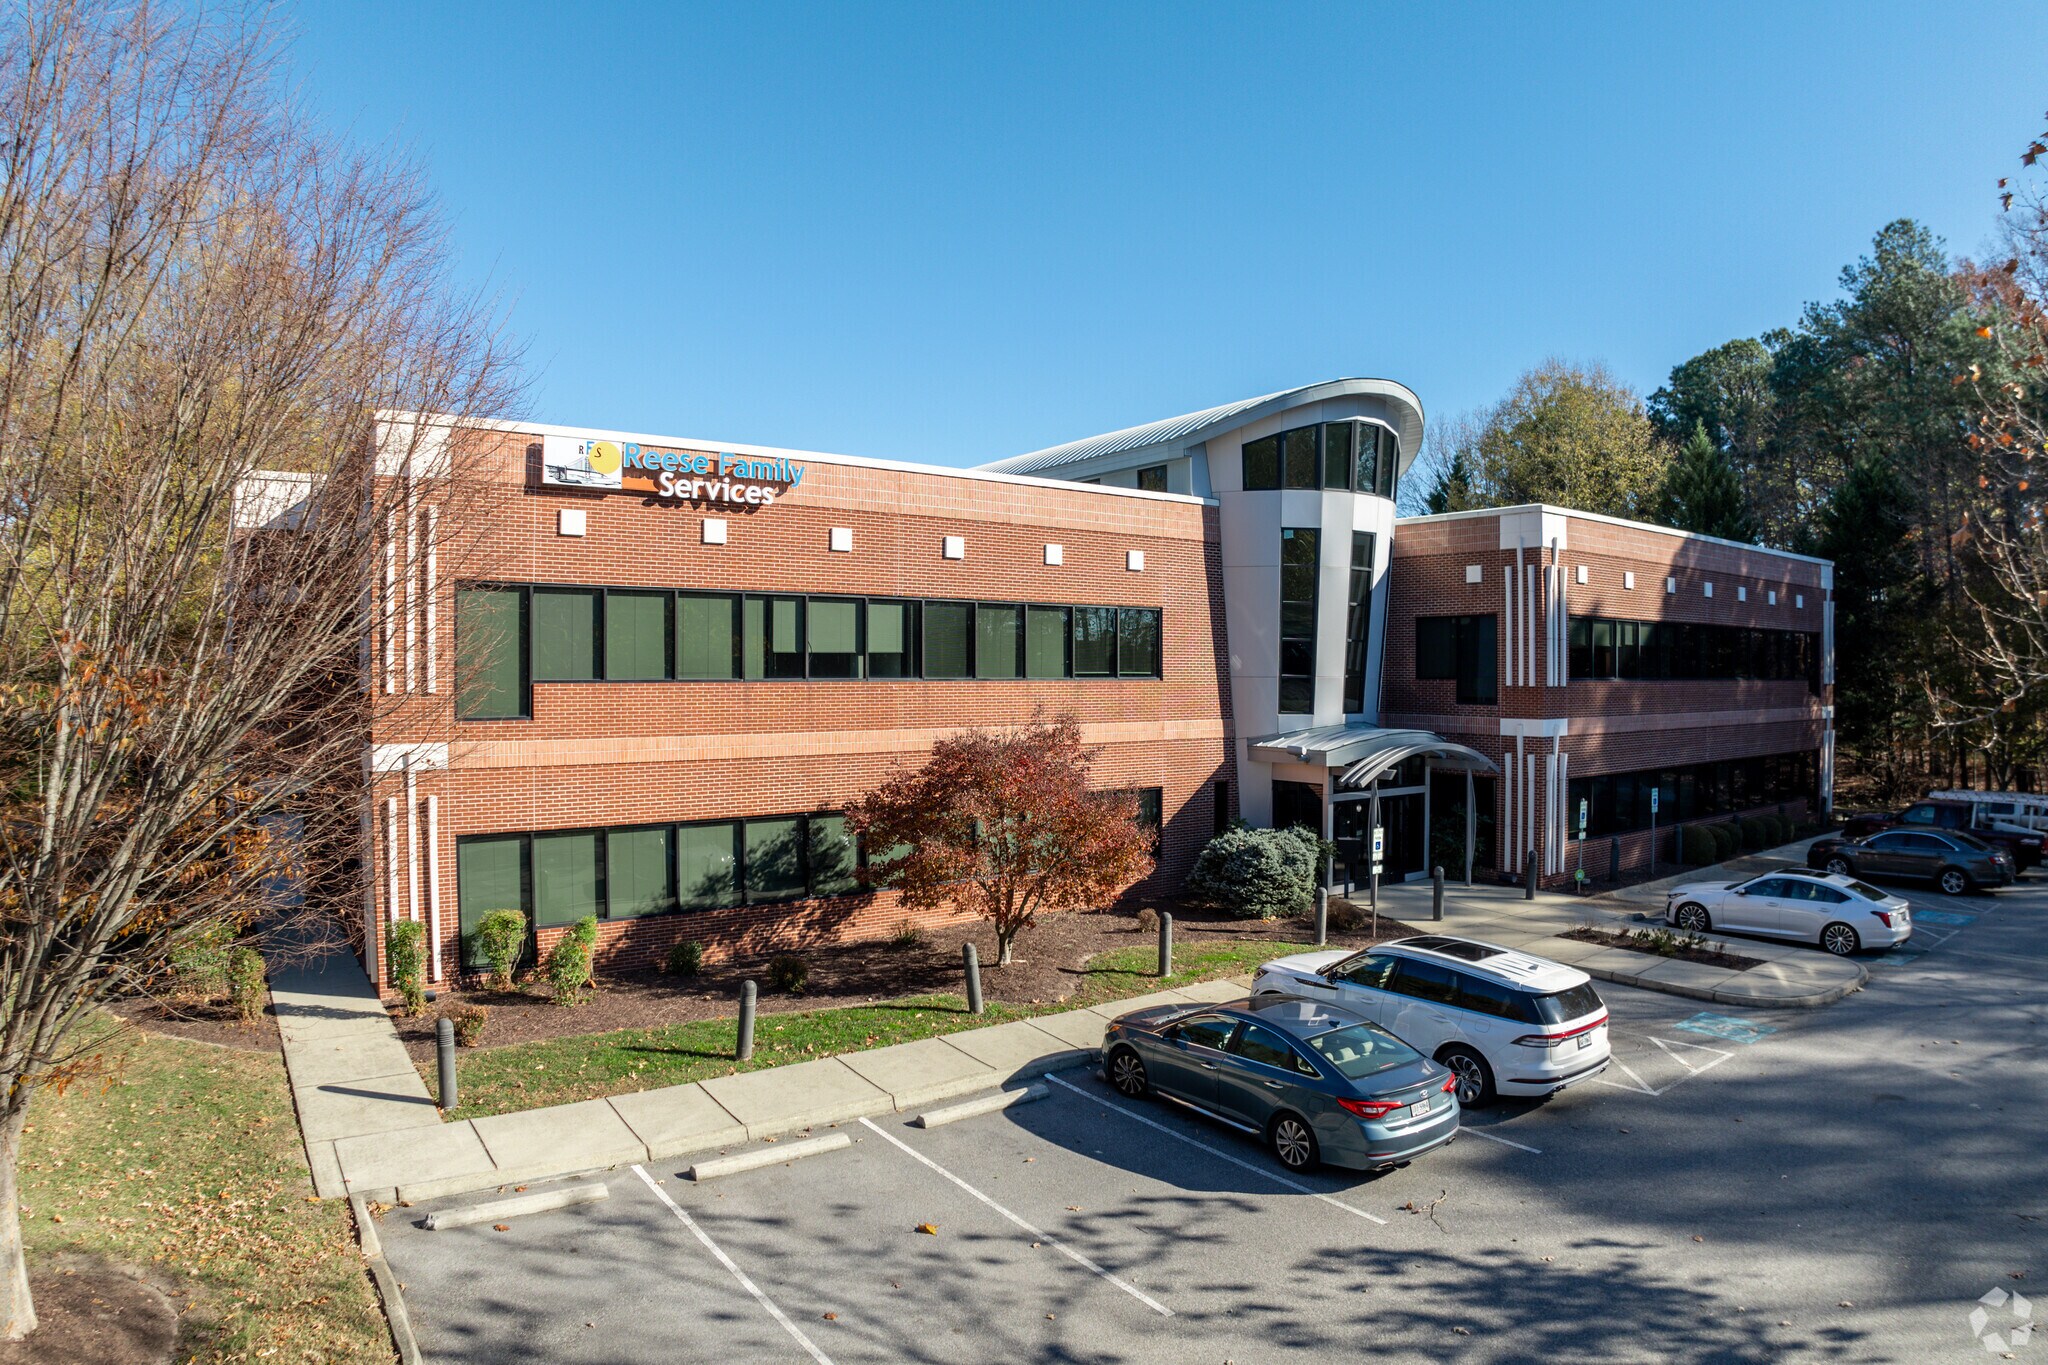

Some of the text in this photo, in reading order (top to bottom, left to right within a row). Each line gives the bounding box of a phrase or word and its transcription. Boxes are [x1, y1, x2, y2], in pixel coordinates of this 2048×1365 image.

[623, 442, 805, 488] Reese Family
[658, 471, 774, 505] Services
